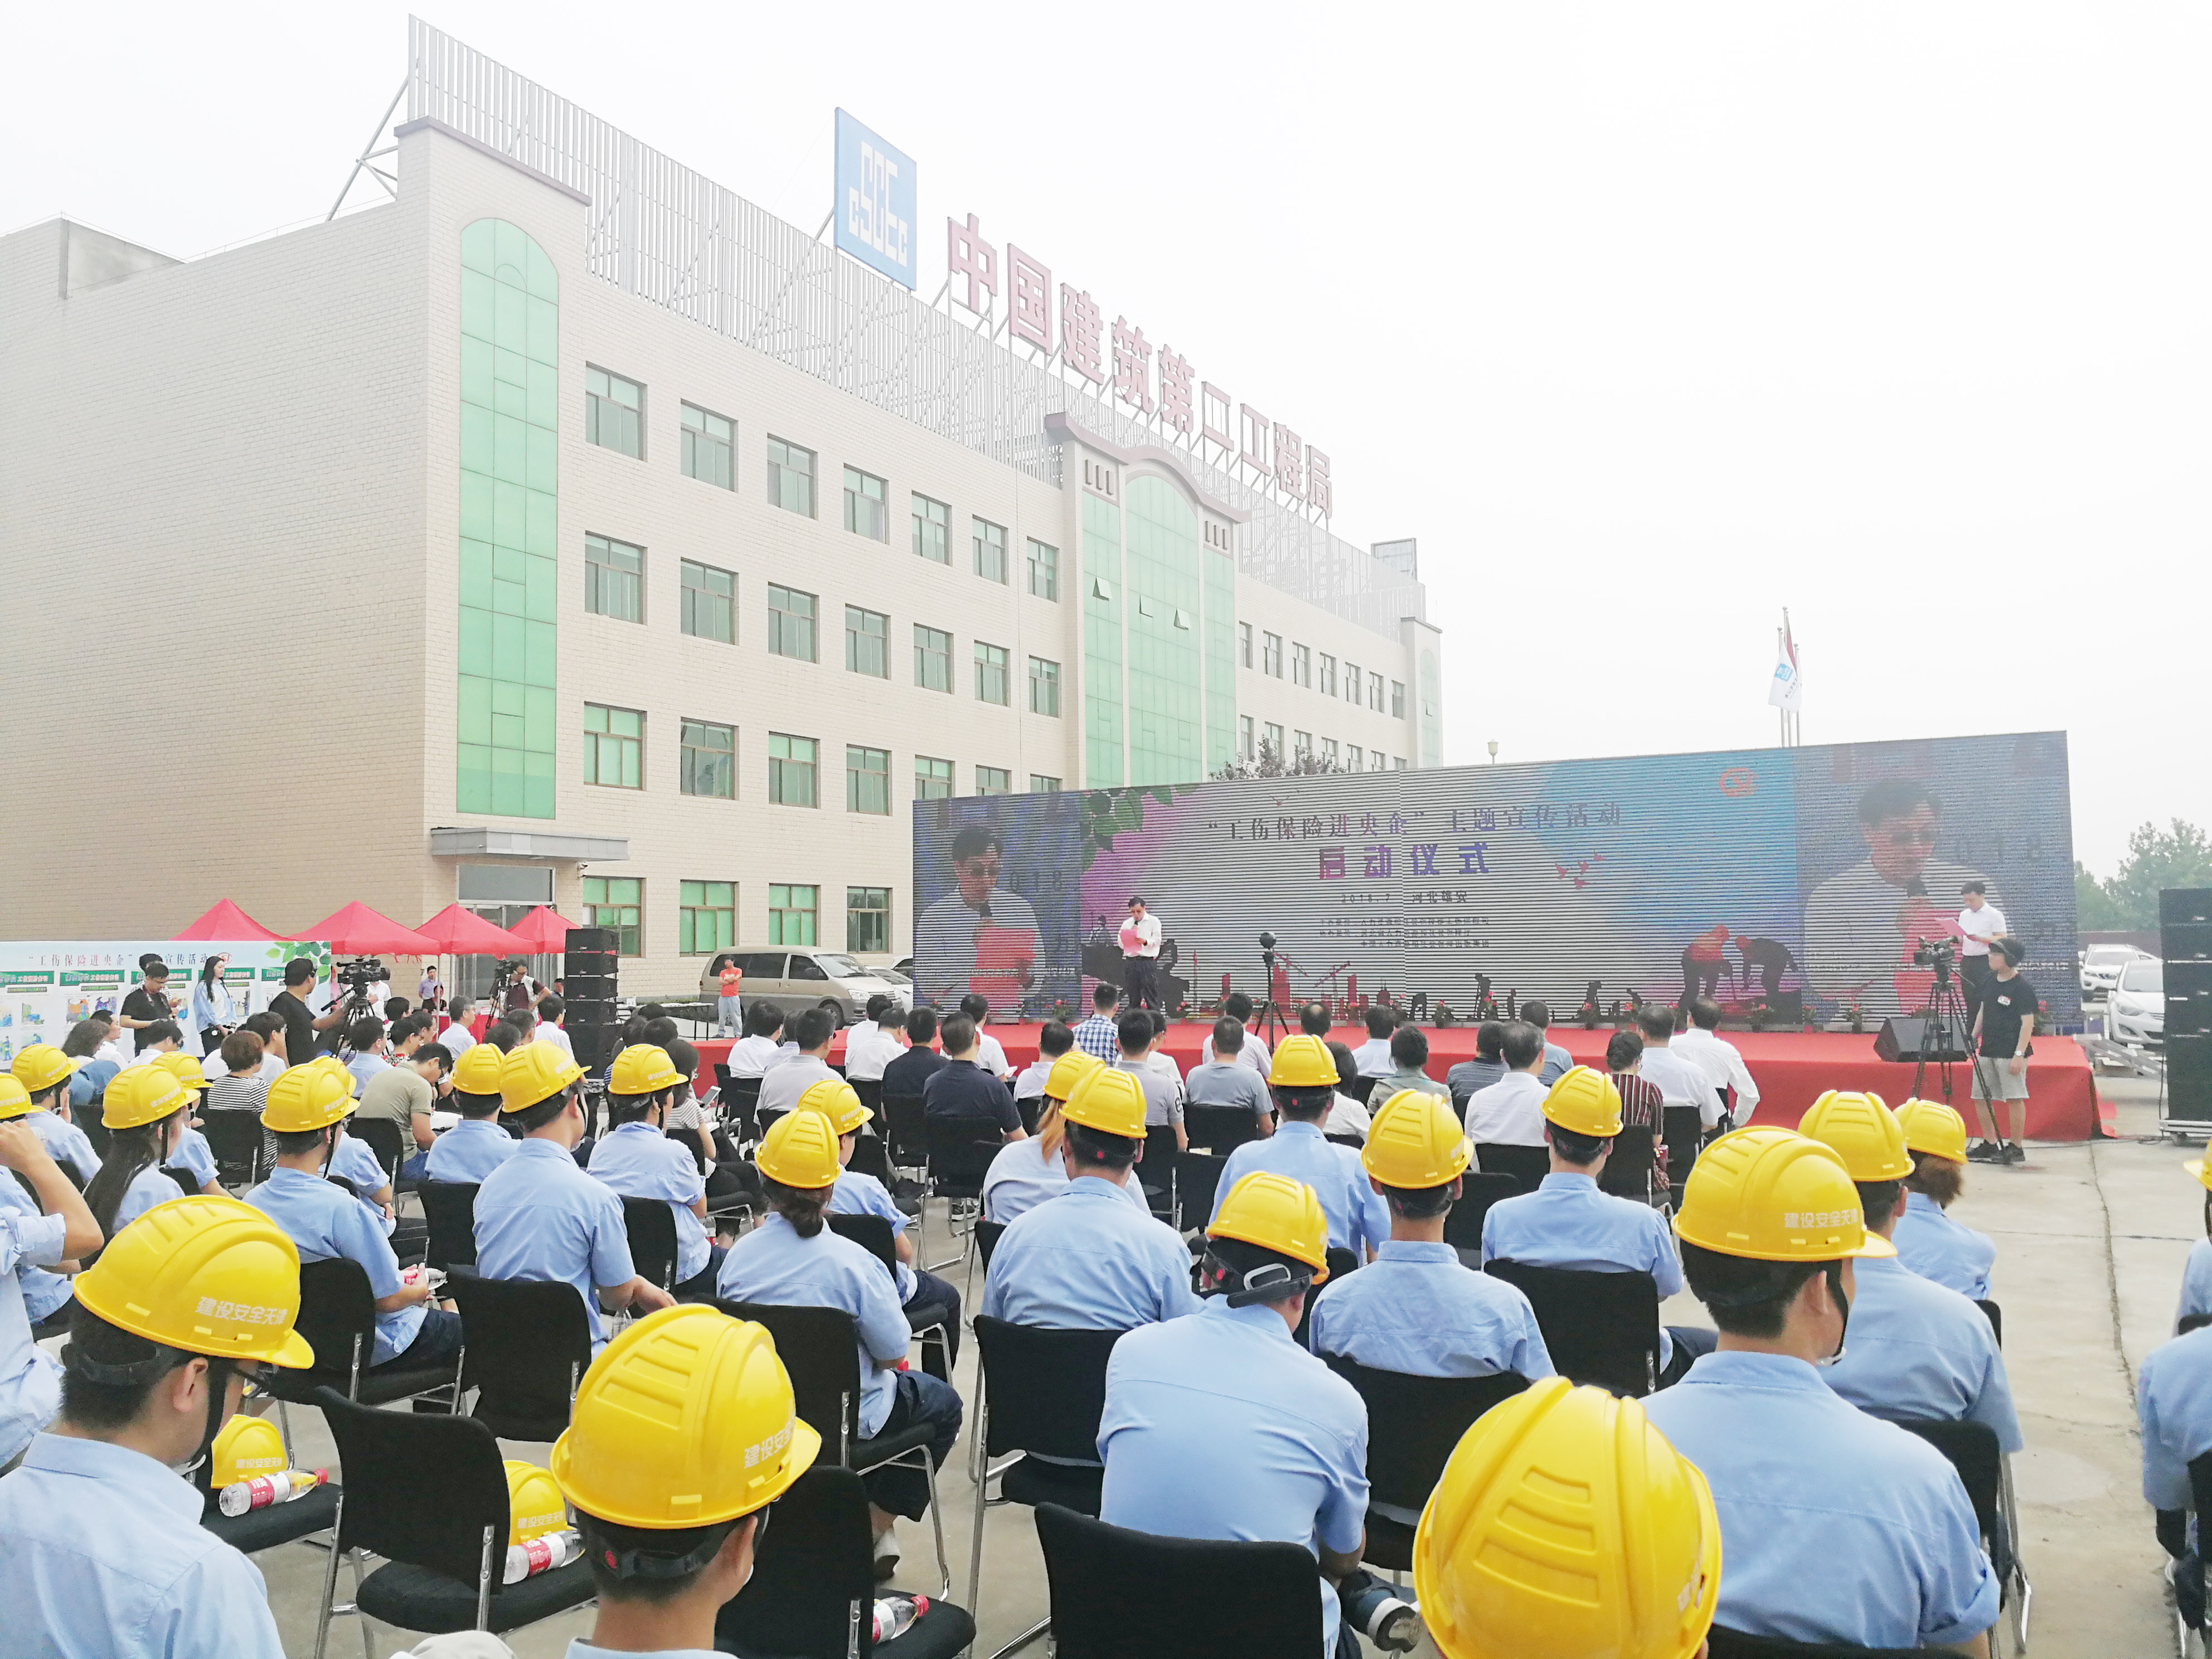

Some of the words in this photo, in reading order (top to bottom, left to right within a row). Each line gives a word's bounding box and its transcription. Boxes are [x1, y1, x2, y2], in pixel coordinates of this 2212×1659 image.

[947, 212, 1332, 520] 中国建筑第二工程局
[1319, 841, 1490, 880] 启动仪式
